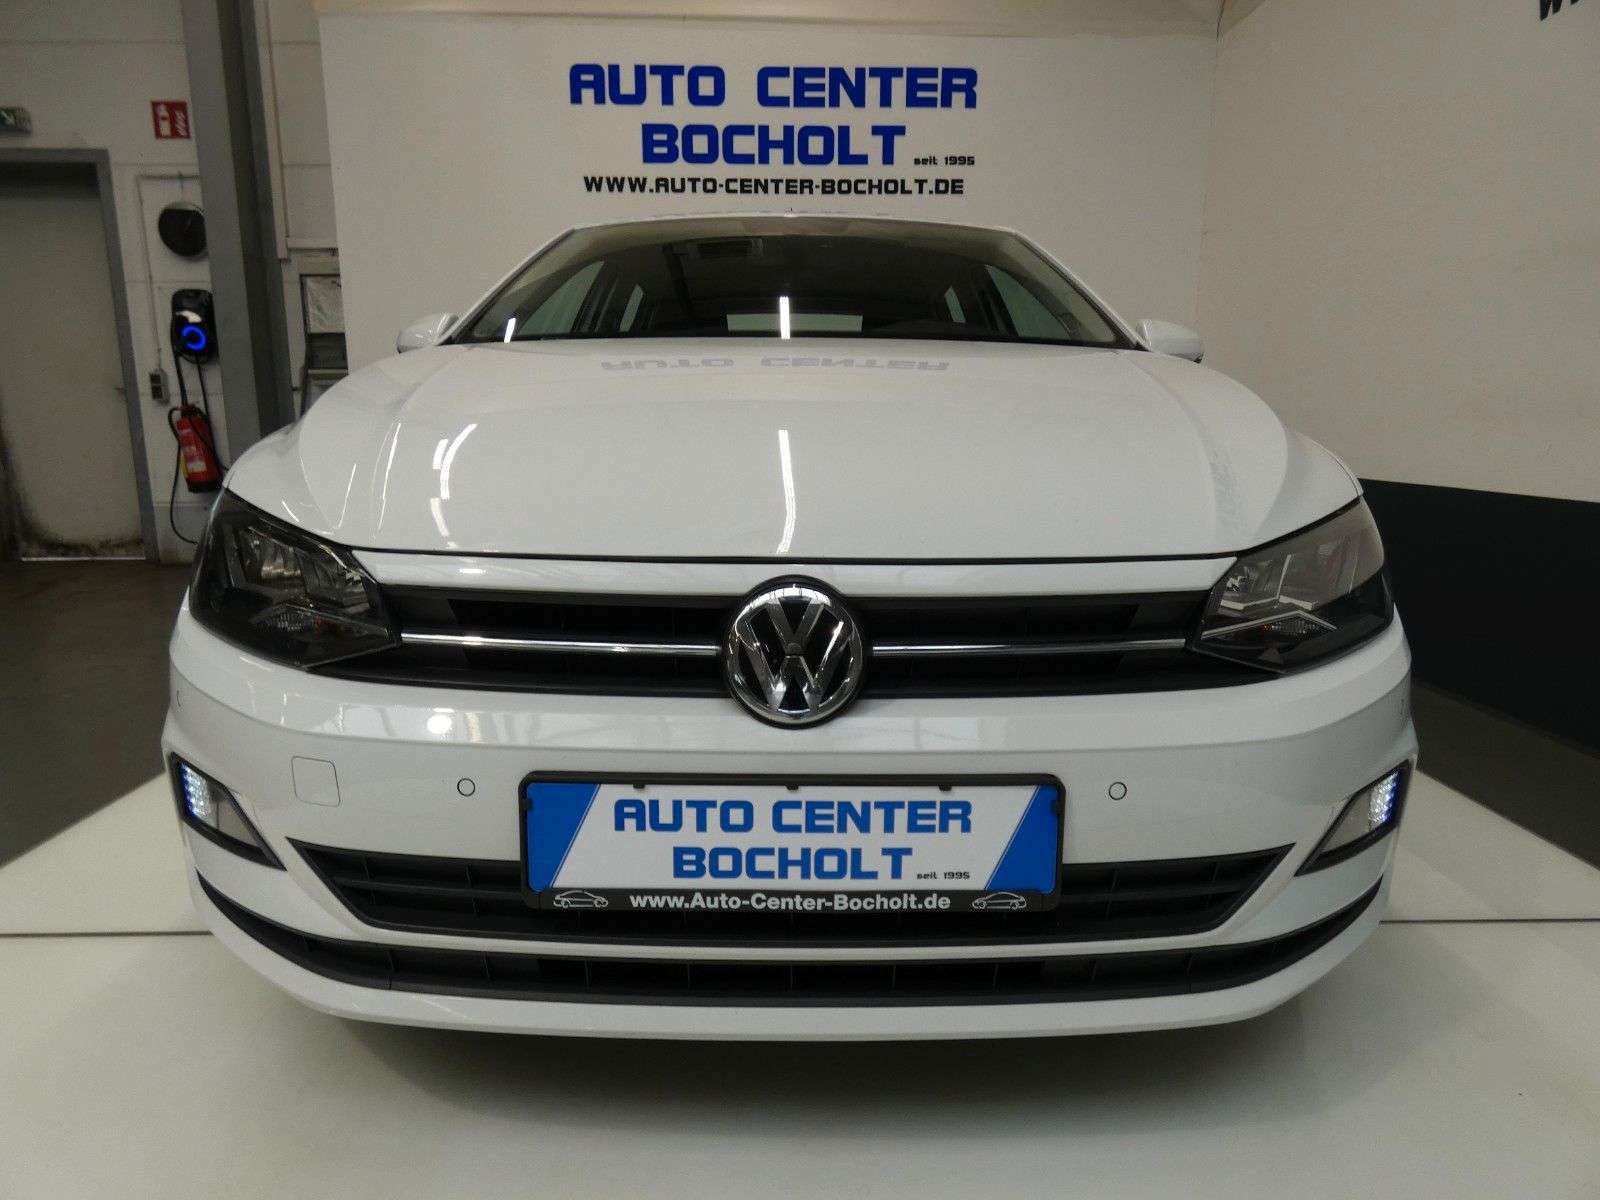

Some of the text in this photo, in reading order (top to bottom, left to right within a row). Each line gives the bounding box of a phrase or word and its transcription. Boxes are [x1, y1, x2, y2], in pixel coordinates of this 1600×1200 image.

[569, 63, 978, 109] AUTO CENTER
[641, 123, 975, 166] BOCHOLT seit 1995
[583, 175, 964, 196] WWW.AUTO-CENTER-BOCHOLT.DE
[613, 798, 972, 834] AUTO CENTER
[672, 845, 970, 881] BOCHOLT seit 1995
[629, 891, 952, 911] www.Auto-Center-Bocholt.de
